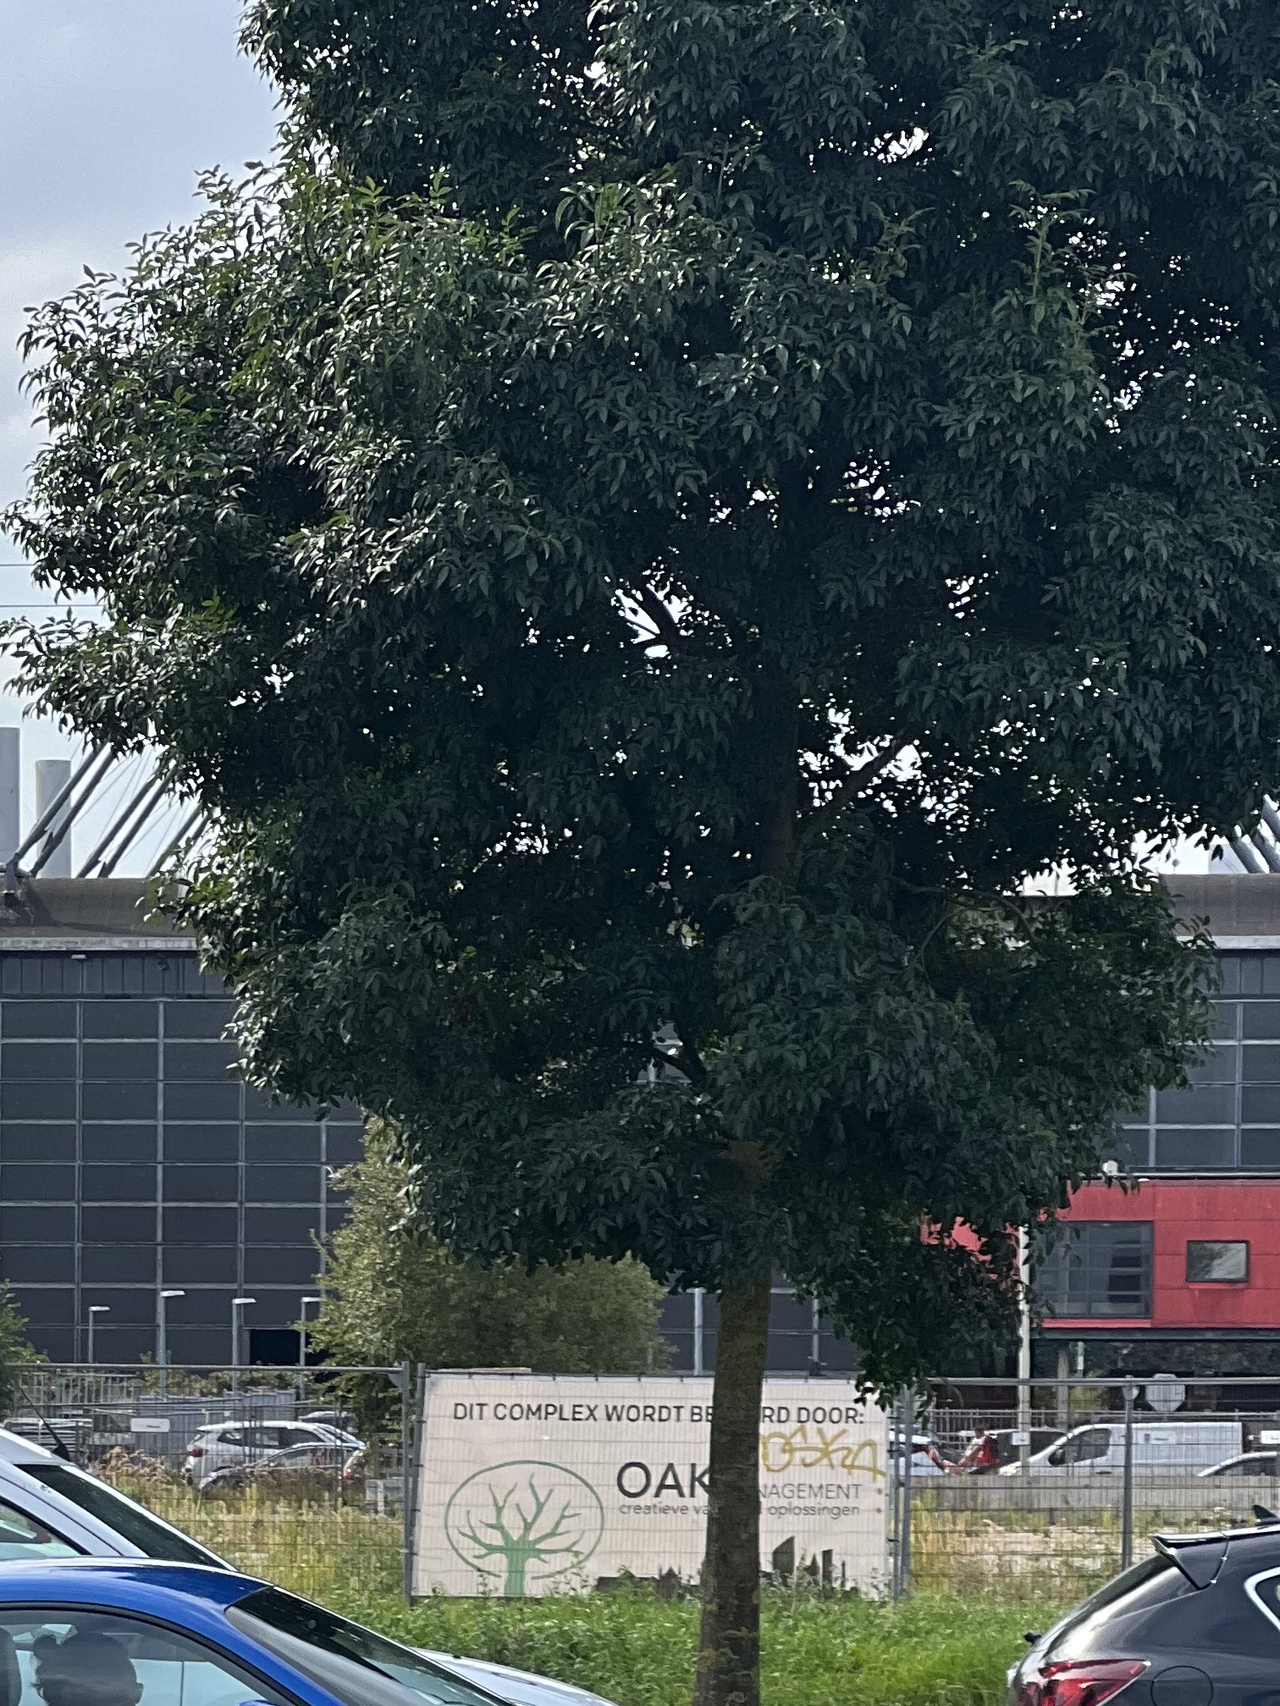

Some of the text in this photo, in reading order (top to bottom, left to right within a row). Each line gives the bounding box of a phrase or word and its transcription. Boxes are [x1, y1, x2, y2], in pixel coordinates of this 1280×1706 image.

[454, 1402, 487, 1421] DIT
[494, 1403, 598, 1422] COMPLEX
[605, 1405, 684, 1422] WORDT
[797, 1407, 864, 1425] DOOR:
[617, 1461, 710, 1498] OAK
[620, 1501, 689, 1515] creatieve
[770, 1501, 860, 1520] oplossingen
